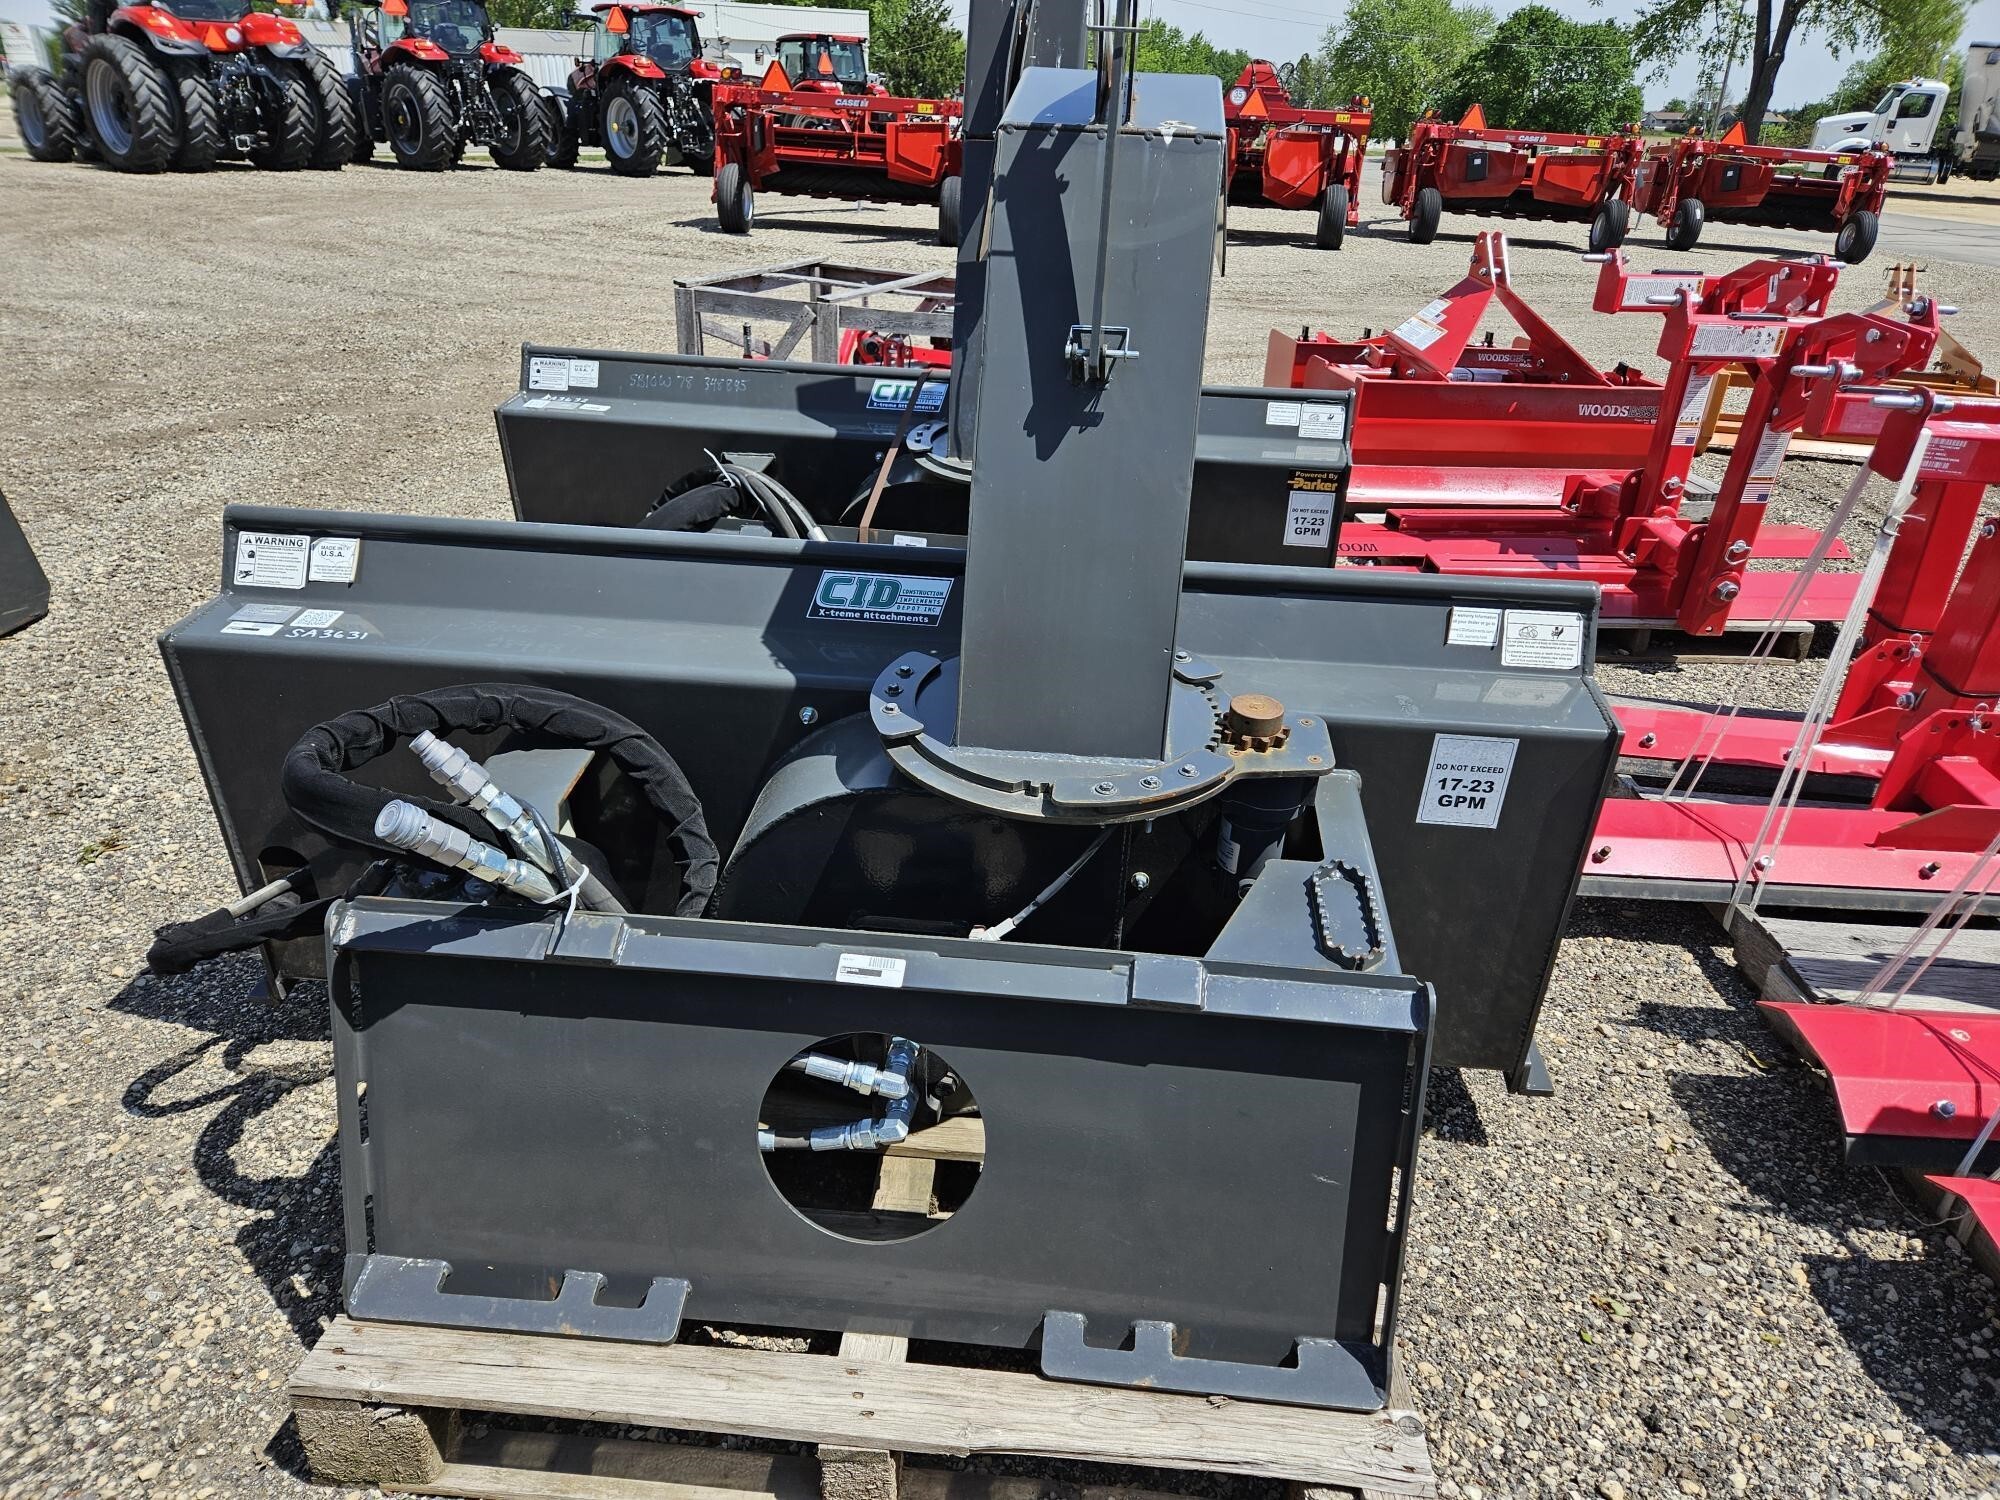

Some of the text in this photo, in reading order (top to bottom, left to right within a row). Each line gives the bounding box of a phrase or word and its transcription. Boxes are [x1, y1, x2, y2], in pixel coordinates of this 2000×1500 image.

[835, 98, 860, 107] CASE
[1518, 135, 1539, 143] CASE
[540, 359, 566, 367] WARNING
[1478, 353, 1510, 362] WOODS
[676, 375, 694, 390] 78
[1578, 404, 1629, 417] WOODS
[1295, 471, 1338, 480] Powered By
[1290, 479, 1338, 492] Parker
[1293, 516, 1325, 527] 17-23
[1294, 527, 1321, 537] GPM
[255, 536, 304, 547] WARNING
[320, 550, 345, 558] U.S.A.
[819, 575, 902, 609] CID
[902, 588, 944, 597] CONSTRUCTION
[899, 596, 941, 605] IMPLEMENTS
[896, 603, 937, 613] DEPOT INC
[818, 608, 929, 623] X-treme Attachments
[284, 628, 369, 640] SA3631
[1436, 763, 1504, 774] DO NOT EXCEED
[1438, 777, 1495, 793] 17-23
[1437, 794, 1486, 810] GPM
